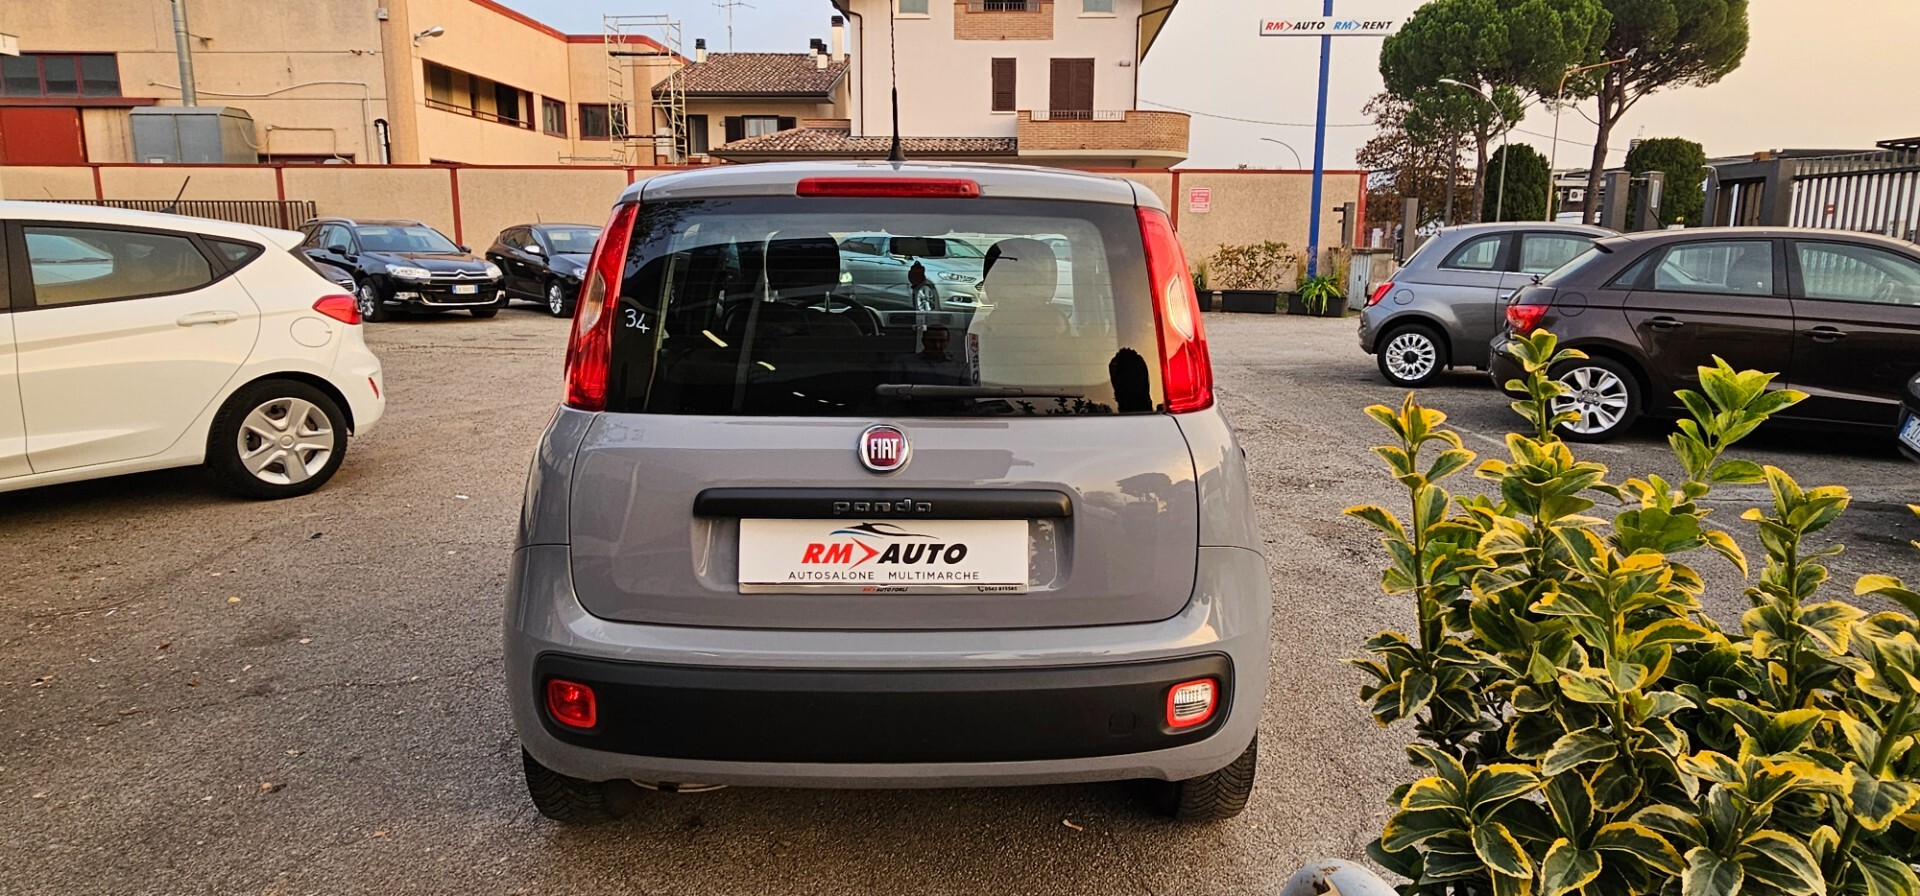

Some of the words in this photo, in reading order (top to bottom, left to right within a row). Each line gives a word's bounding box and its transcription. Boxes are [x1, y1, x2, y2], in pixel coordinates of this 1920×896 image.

[625, 308, 651, 334] 34
[870, 437, 900, 460] FIAT
[833, 498, 932, 515] panda
[788, 571, 875, 580] AUTOSALONE
[888, 571, 980, 580] MULTIMARCHE
